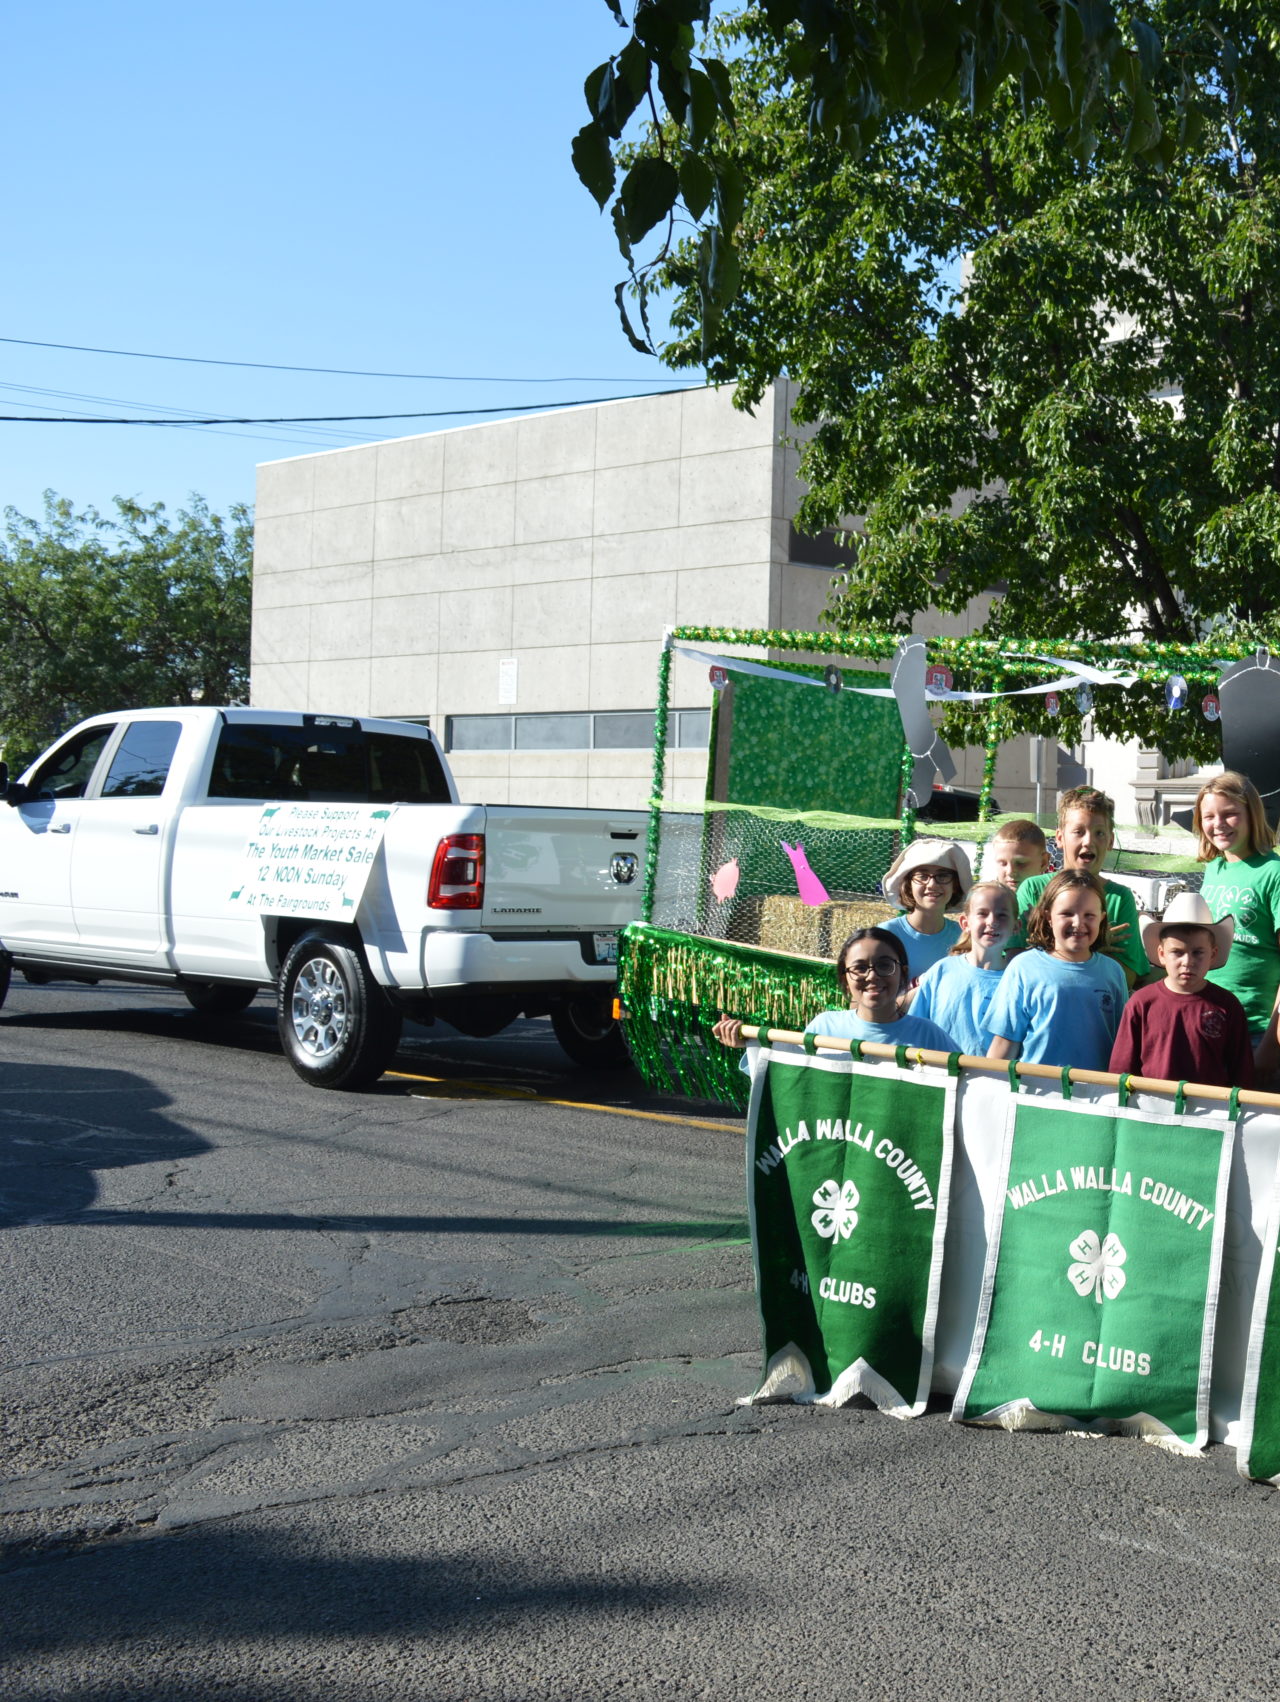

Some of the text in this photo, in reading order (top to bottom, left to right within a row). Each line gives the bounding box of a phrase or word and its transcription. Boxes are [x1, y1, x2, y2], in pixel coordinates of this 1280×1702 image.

[290, 807, 359, 820] Please Support
[258, 824, 376, 841] Our Livestock Projects At
[246, 843, 374, 864] The Youth Market Sale
[257, 866, 348, 891] 12 NOON Sunday
[247, 893, 330, 912] At The Fairgrounds
[755, 1118, 935, 1211] WALLA WALLA COUNTY
[1006, 1166, 1215, 1231] WALLA WALLA COUNTY
[789, 1268, 876, 1309] 4-H CLUBS
[1029, 1329, 1151, 1376] 4-H CLUBS
